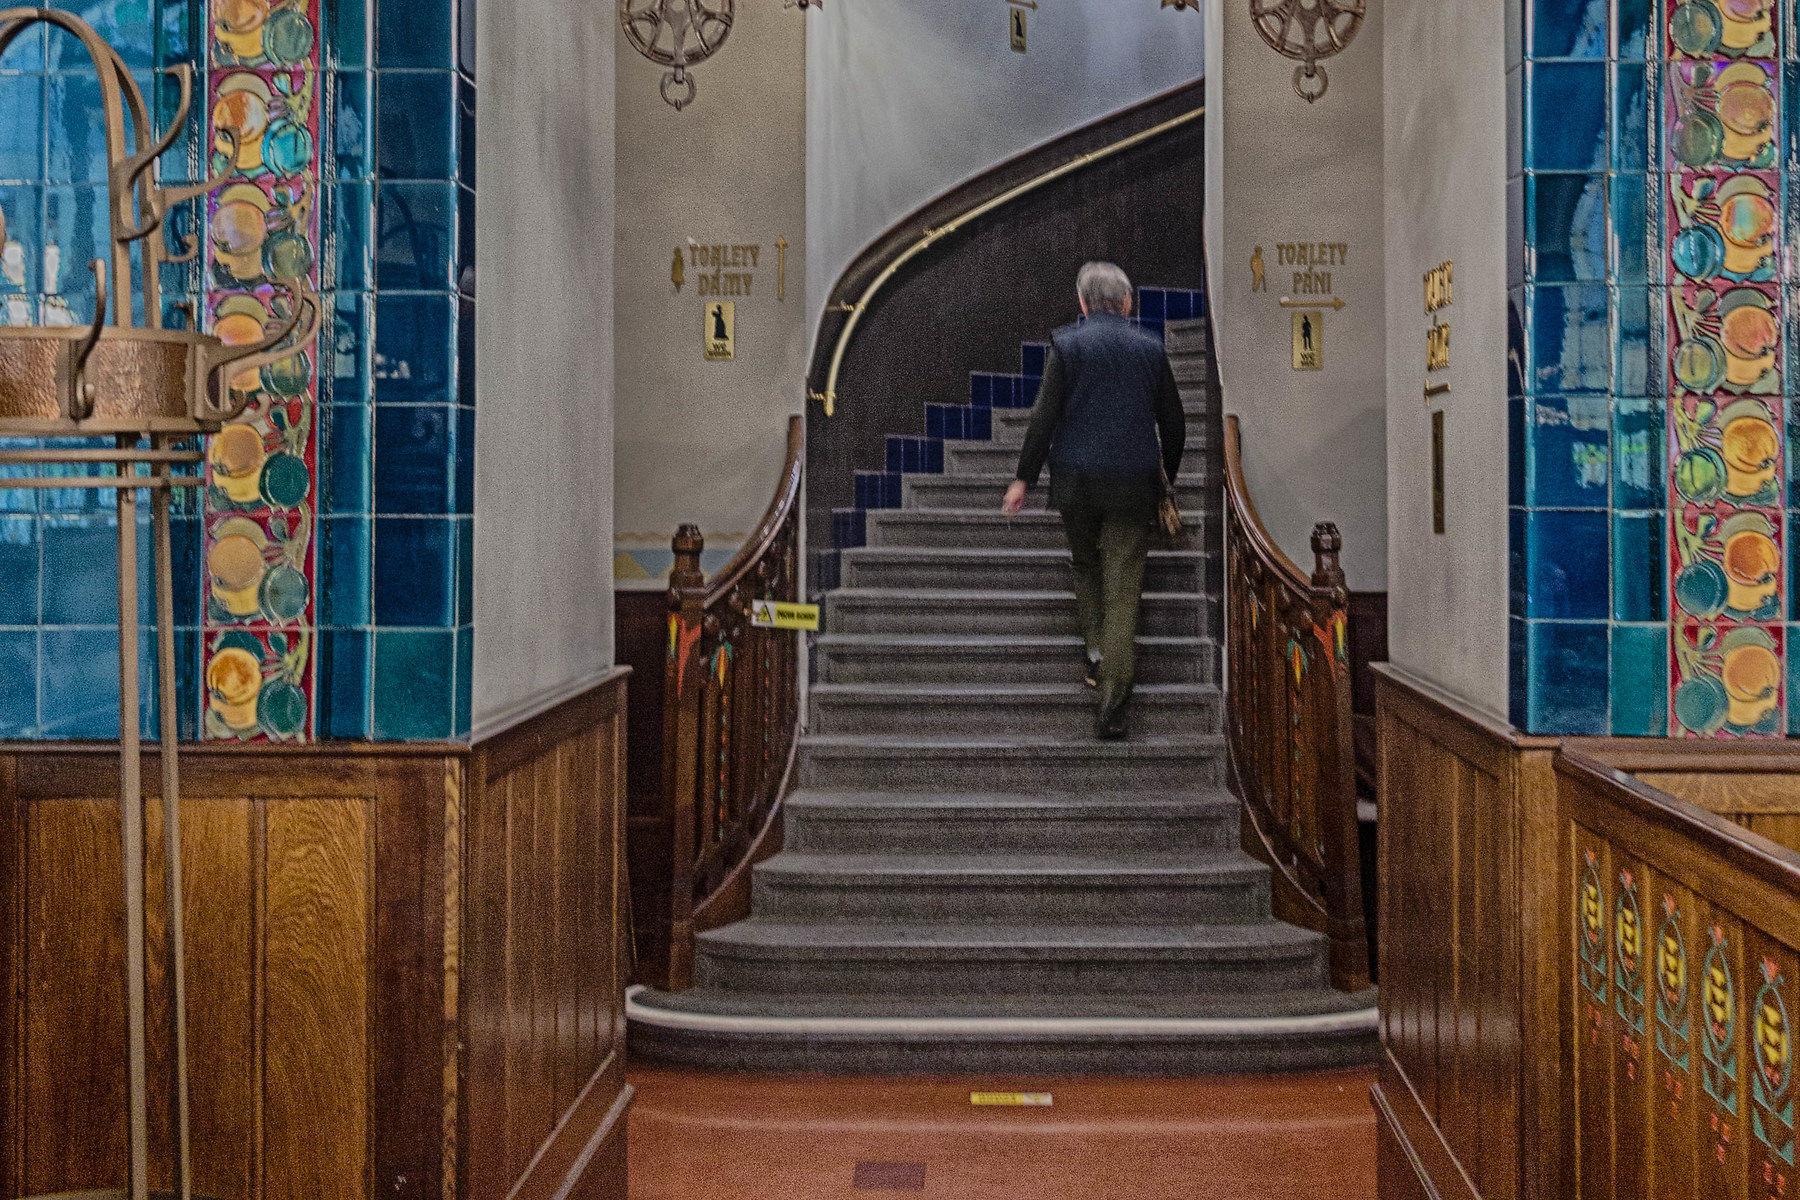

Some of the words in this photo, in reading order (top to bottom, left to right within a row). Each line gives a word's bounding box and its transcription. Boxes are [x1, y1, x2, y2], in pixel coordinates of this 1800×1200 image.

[689, 243, 760, 267] TOALETY
[1276, 243, 1348, 266] TOALETY
[698, 268, 753, 296] DÁMY
[1293, 266, 1332, 295] PÁNI
